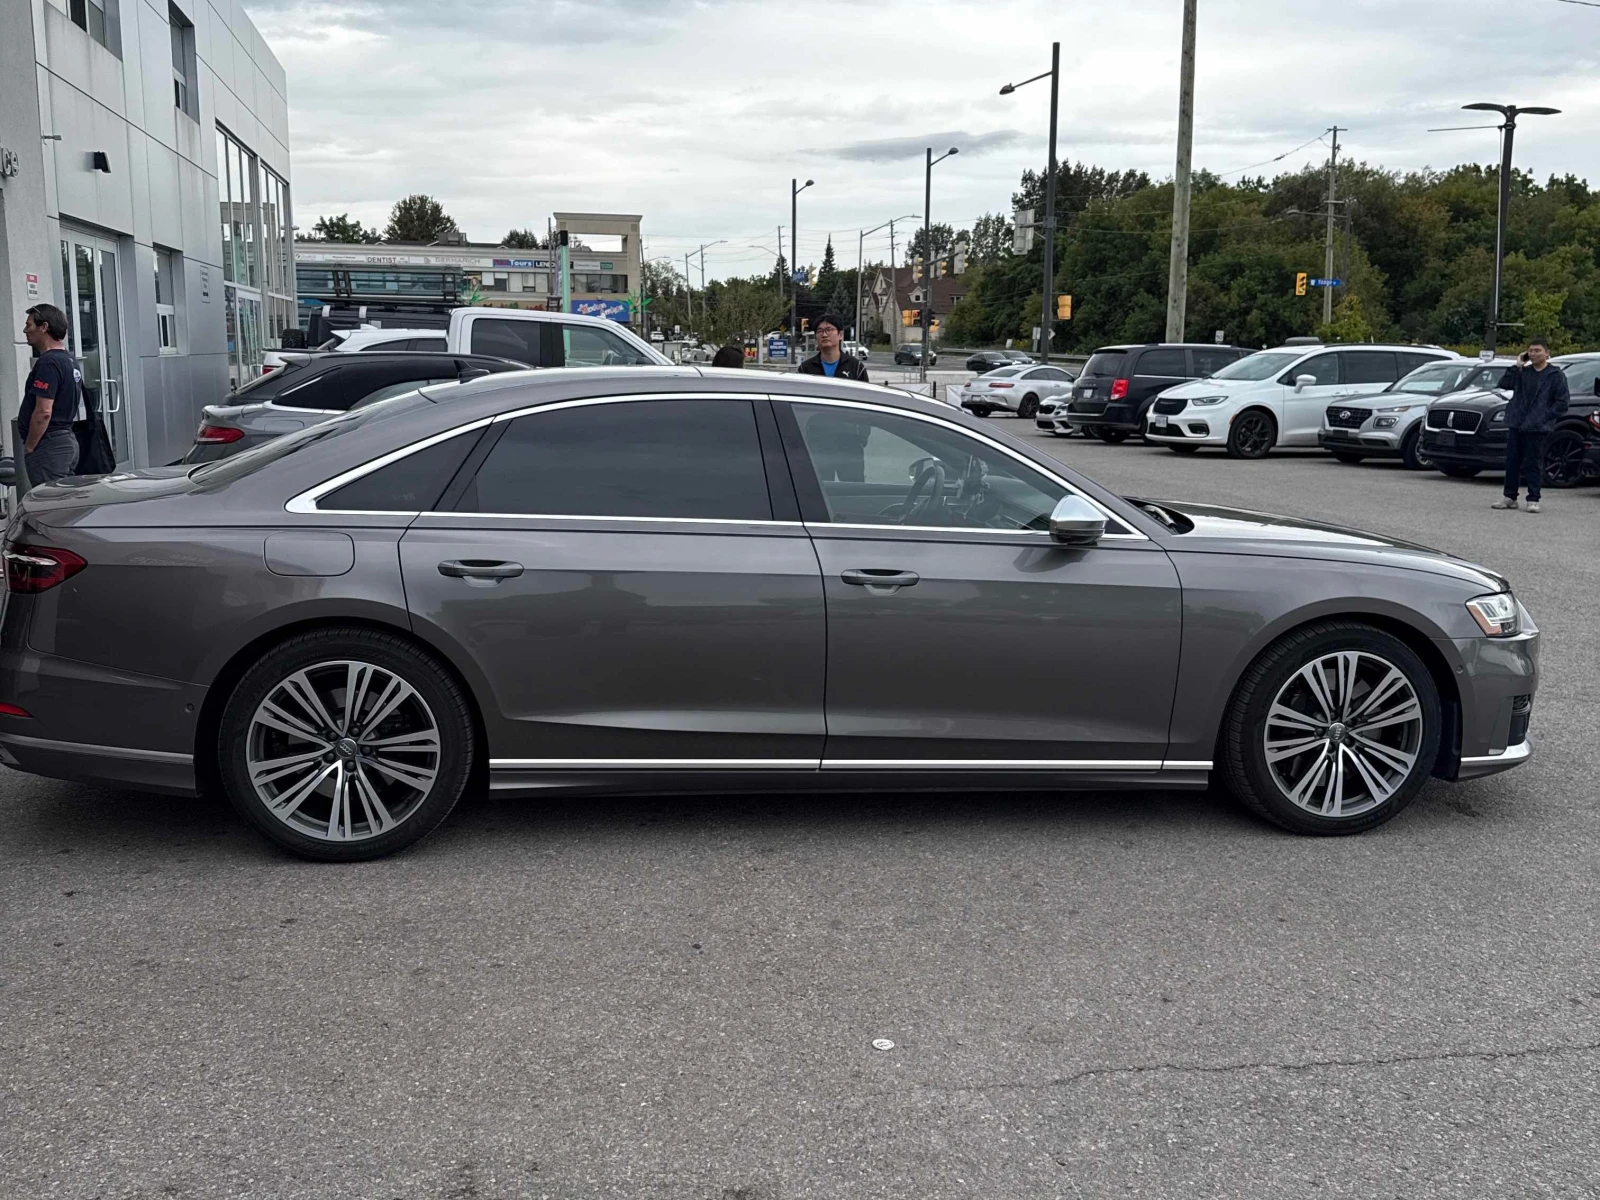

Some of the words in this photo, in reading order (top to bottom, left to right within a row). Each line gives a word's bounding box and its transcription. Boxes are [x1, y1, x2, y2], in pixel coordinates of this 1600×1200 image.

[367, 256, 397, 264] DENTIST
[509, 259, 532, 267] Tours
[33, 379, 49, 390] 3M
